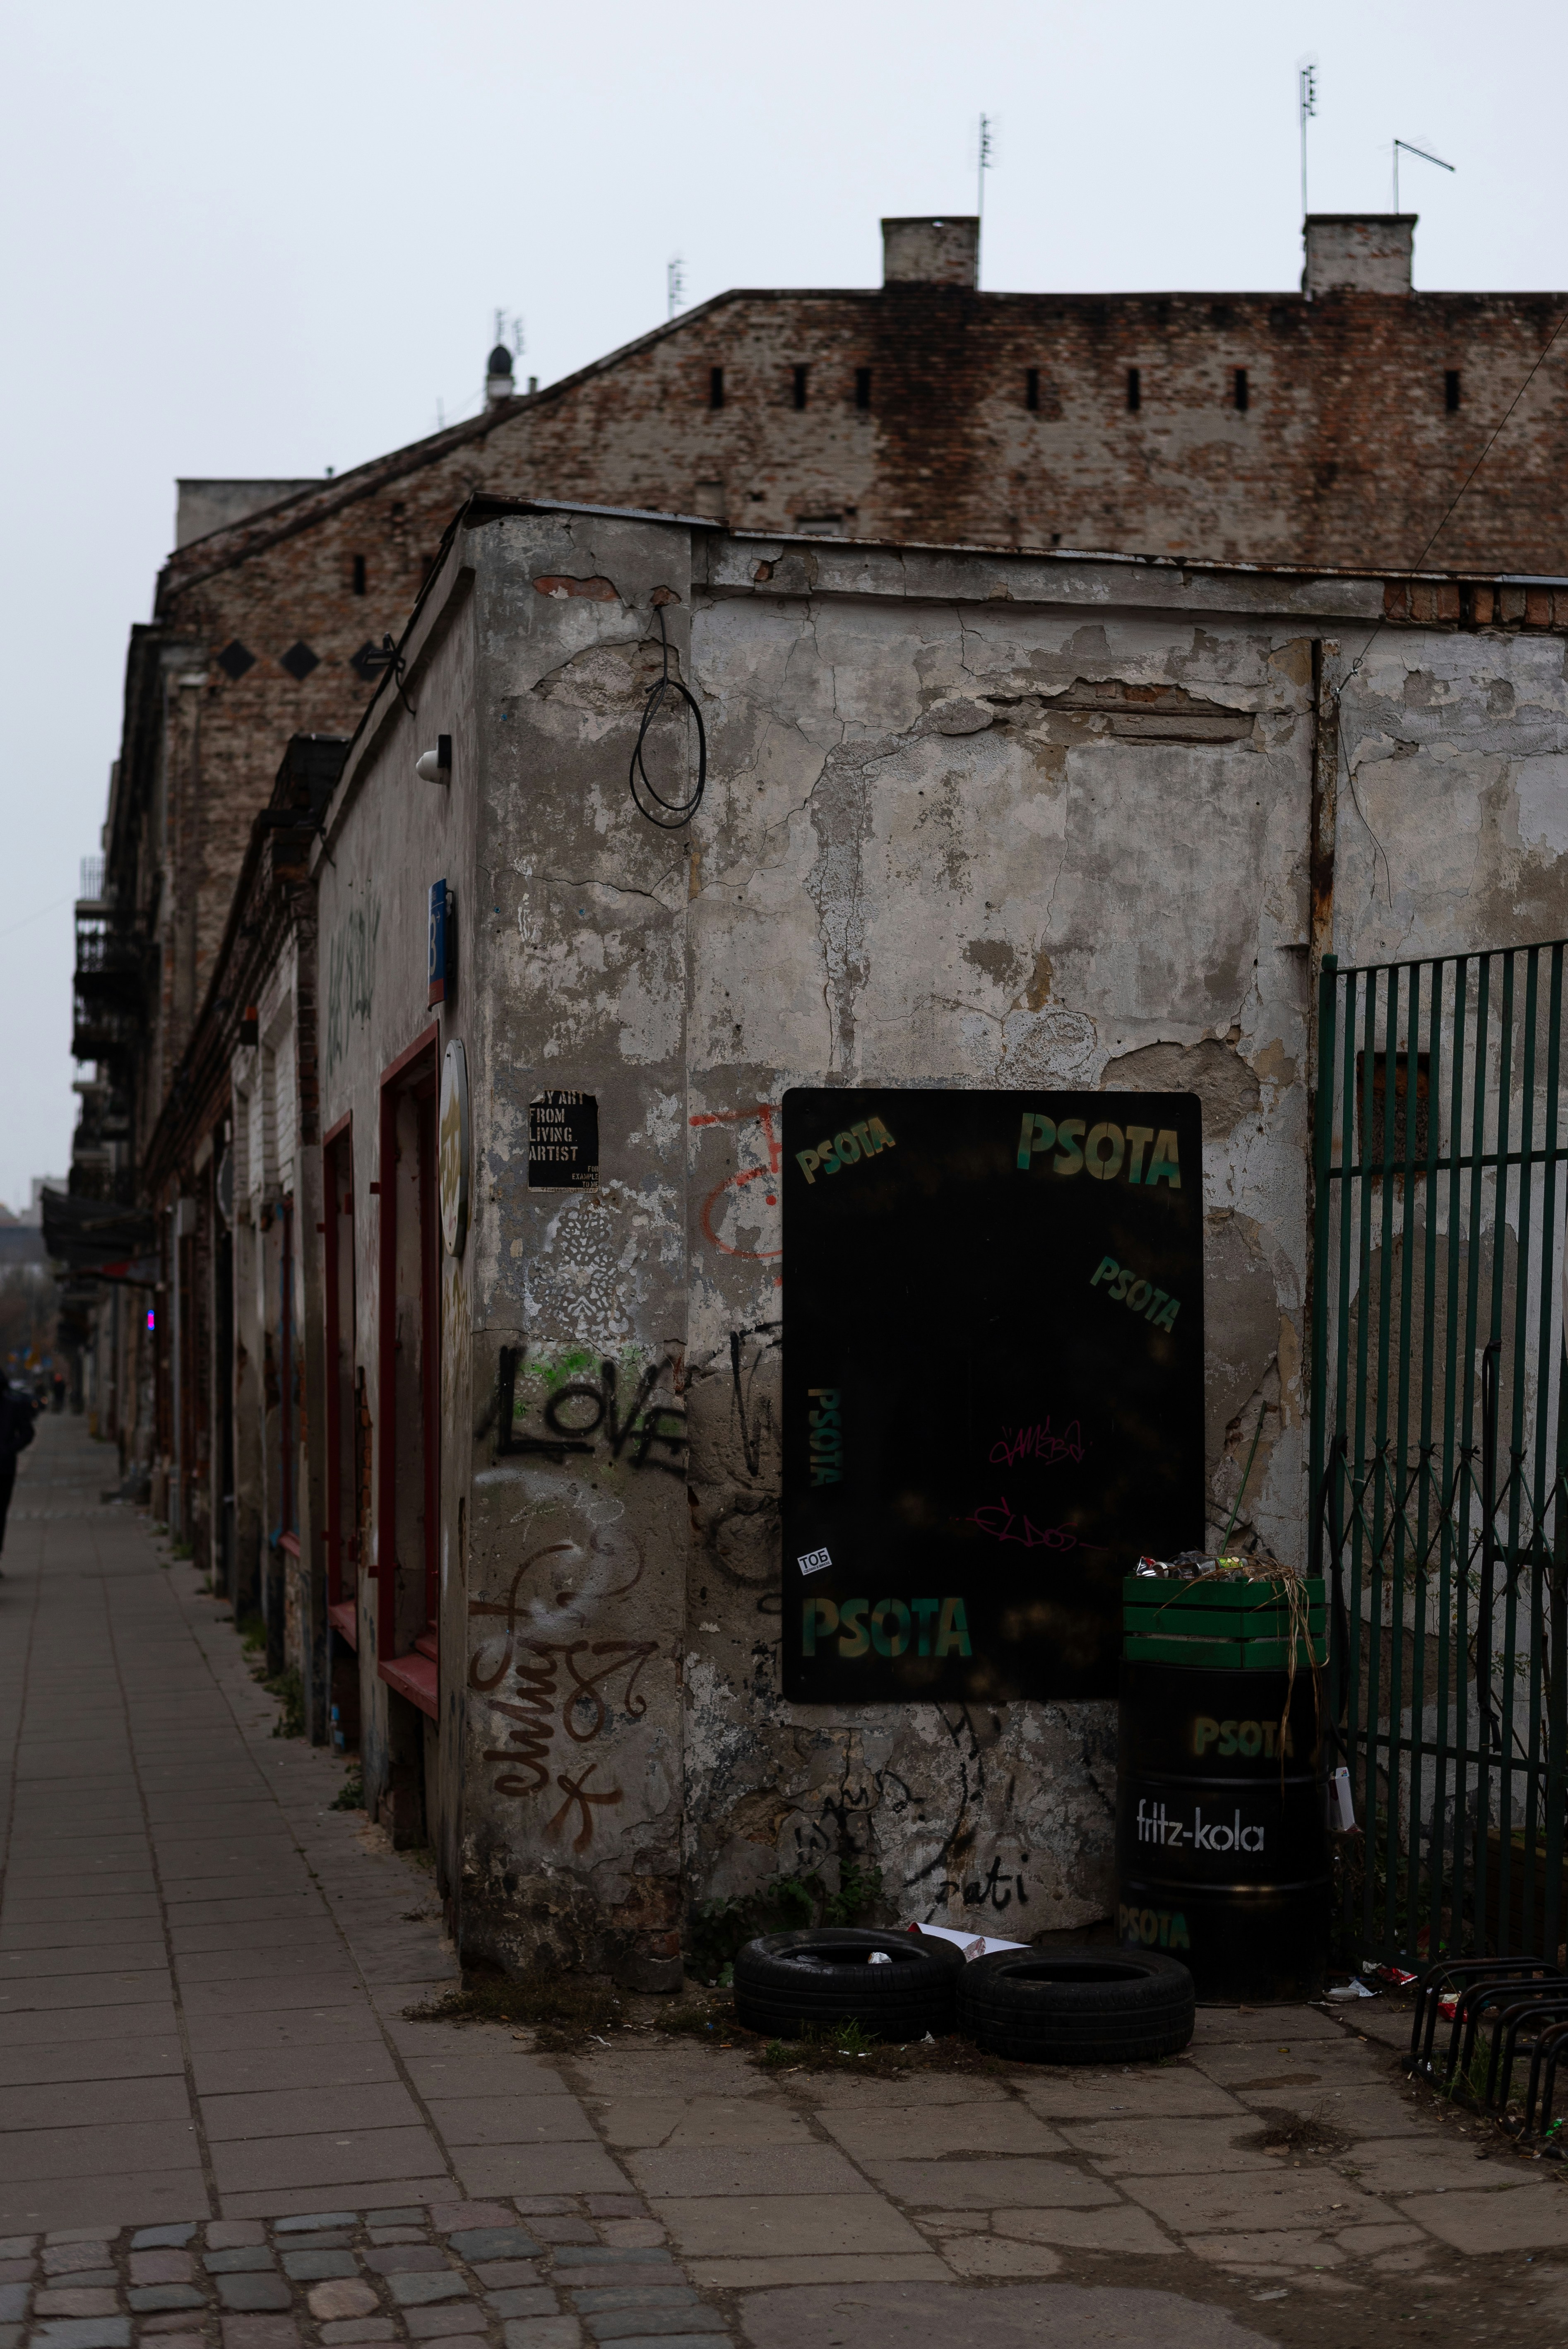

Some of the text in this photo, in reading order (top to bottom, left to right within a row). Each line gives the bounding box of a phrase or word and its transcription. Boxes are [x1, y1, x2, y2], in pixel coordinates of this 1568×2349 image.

[529, 1107, 565, 1123] FROM
[559, 1090, 584, 1105] ART
[529, 1126, 572, 1142] LIVING
[529, 1145, 578, 1161] ARTIST
[795, 1114, 897, 1184] PSOTA
[1016, 1112, 1182, 1188] PSOTA
[1089, 1256, 1182, 1333] PSOTA
[497, 1345, 688, 1477] LOVE
[808, 1388, 844, 1487] PSOTA
[802, 1597, 973, 1657] PSOTA
[1194, 1716, 1296, 1759] PSOTA
[1136, 1798, 1265, 1852] fritz-kola
[1119, 1903, 1191, 1951] PSOTA
